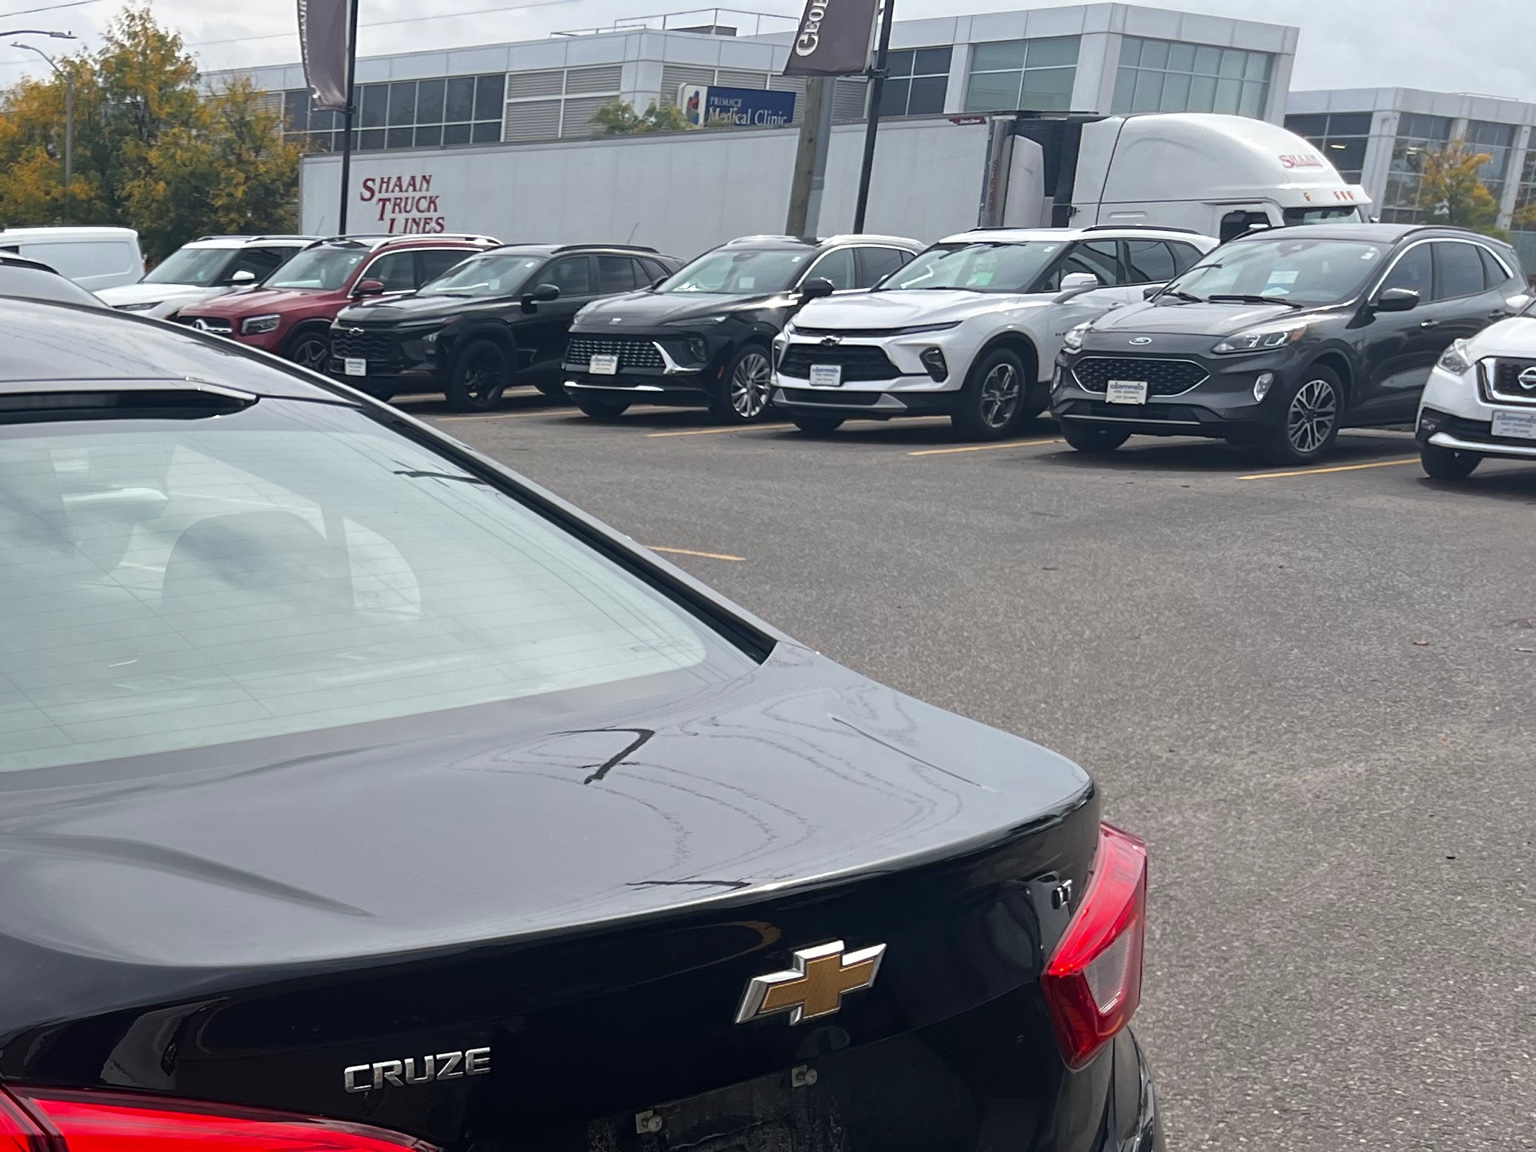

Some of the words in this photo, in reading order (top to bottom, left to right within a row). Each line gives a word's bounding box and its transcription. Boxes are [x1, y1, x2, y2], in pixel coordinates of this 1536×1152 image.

[708, 107, 752, 125] Medical
[754, 109, 788, 126] Clinic
[359, 174, 433, 202] SHAAN
[376, 195, 440, 222] TRUCK
[1056, 879, 1073, 907] LT
[344, 1046, 491, 1094] CRUZE
